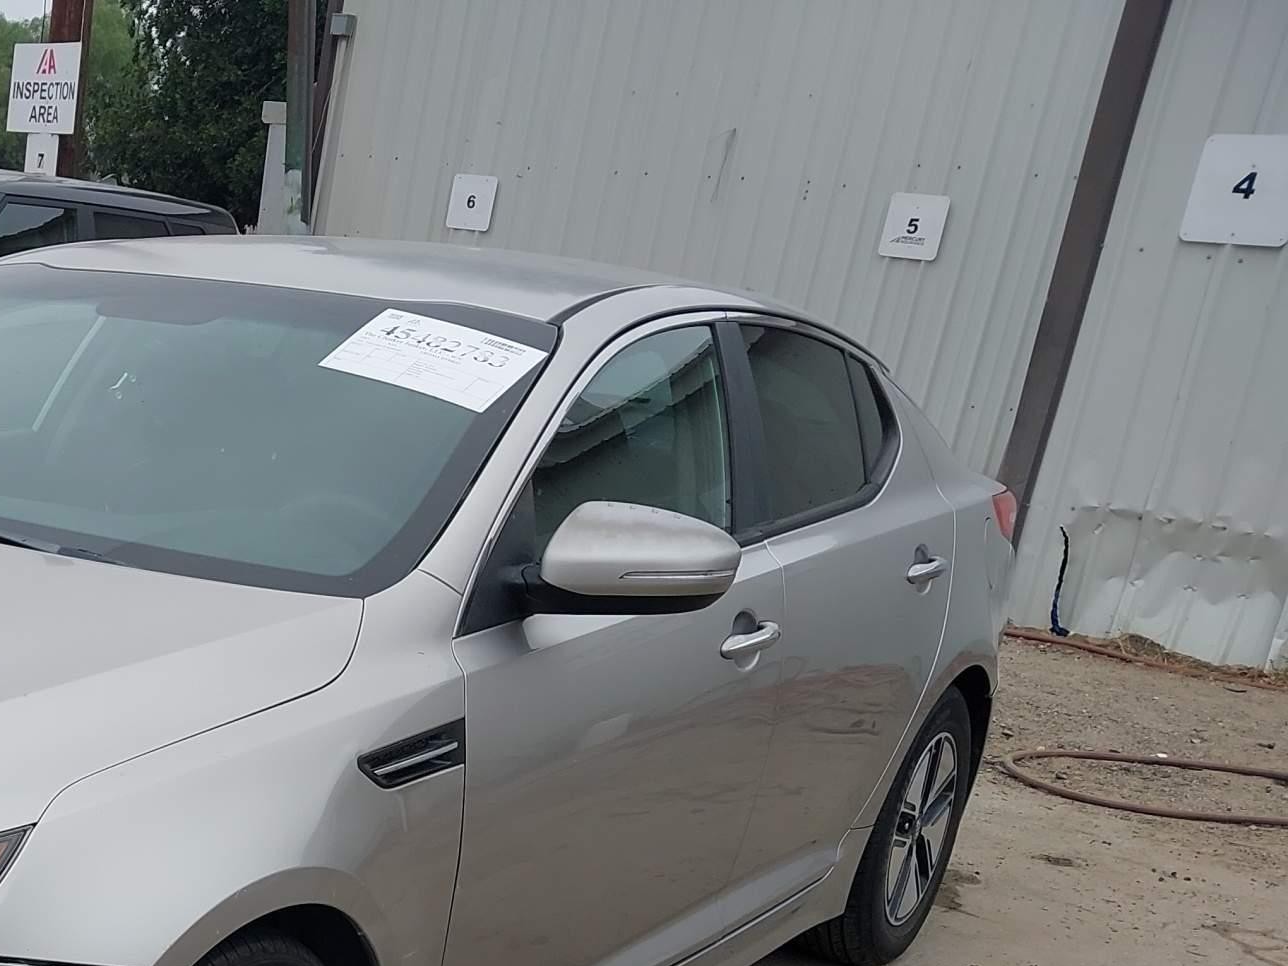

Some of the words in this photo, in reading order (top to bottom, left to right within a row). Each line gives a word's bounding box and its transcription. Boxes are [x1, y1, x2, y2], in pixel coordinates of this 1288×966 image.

[12, 81, 76, 101] INSPECTION
[28, 105, 59, 124] AREA
[36, 153, 45, 169] 7
[1231, 171, 1258, 200] 4
[466, 194, 477, 209] 6
[906, 217, 921, 235] 5
